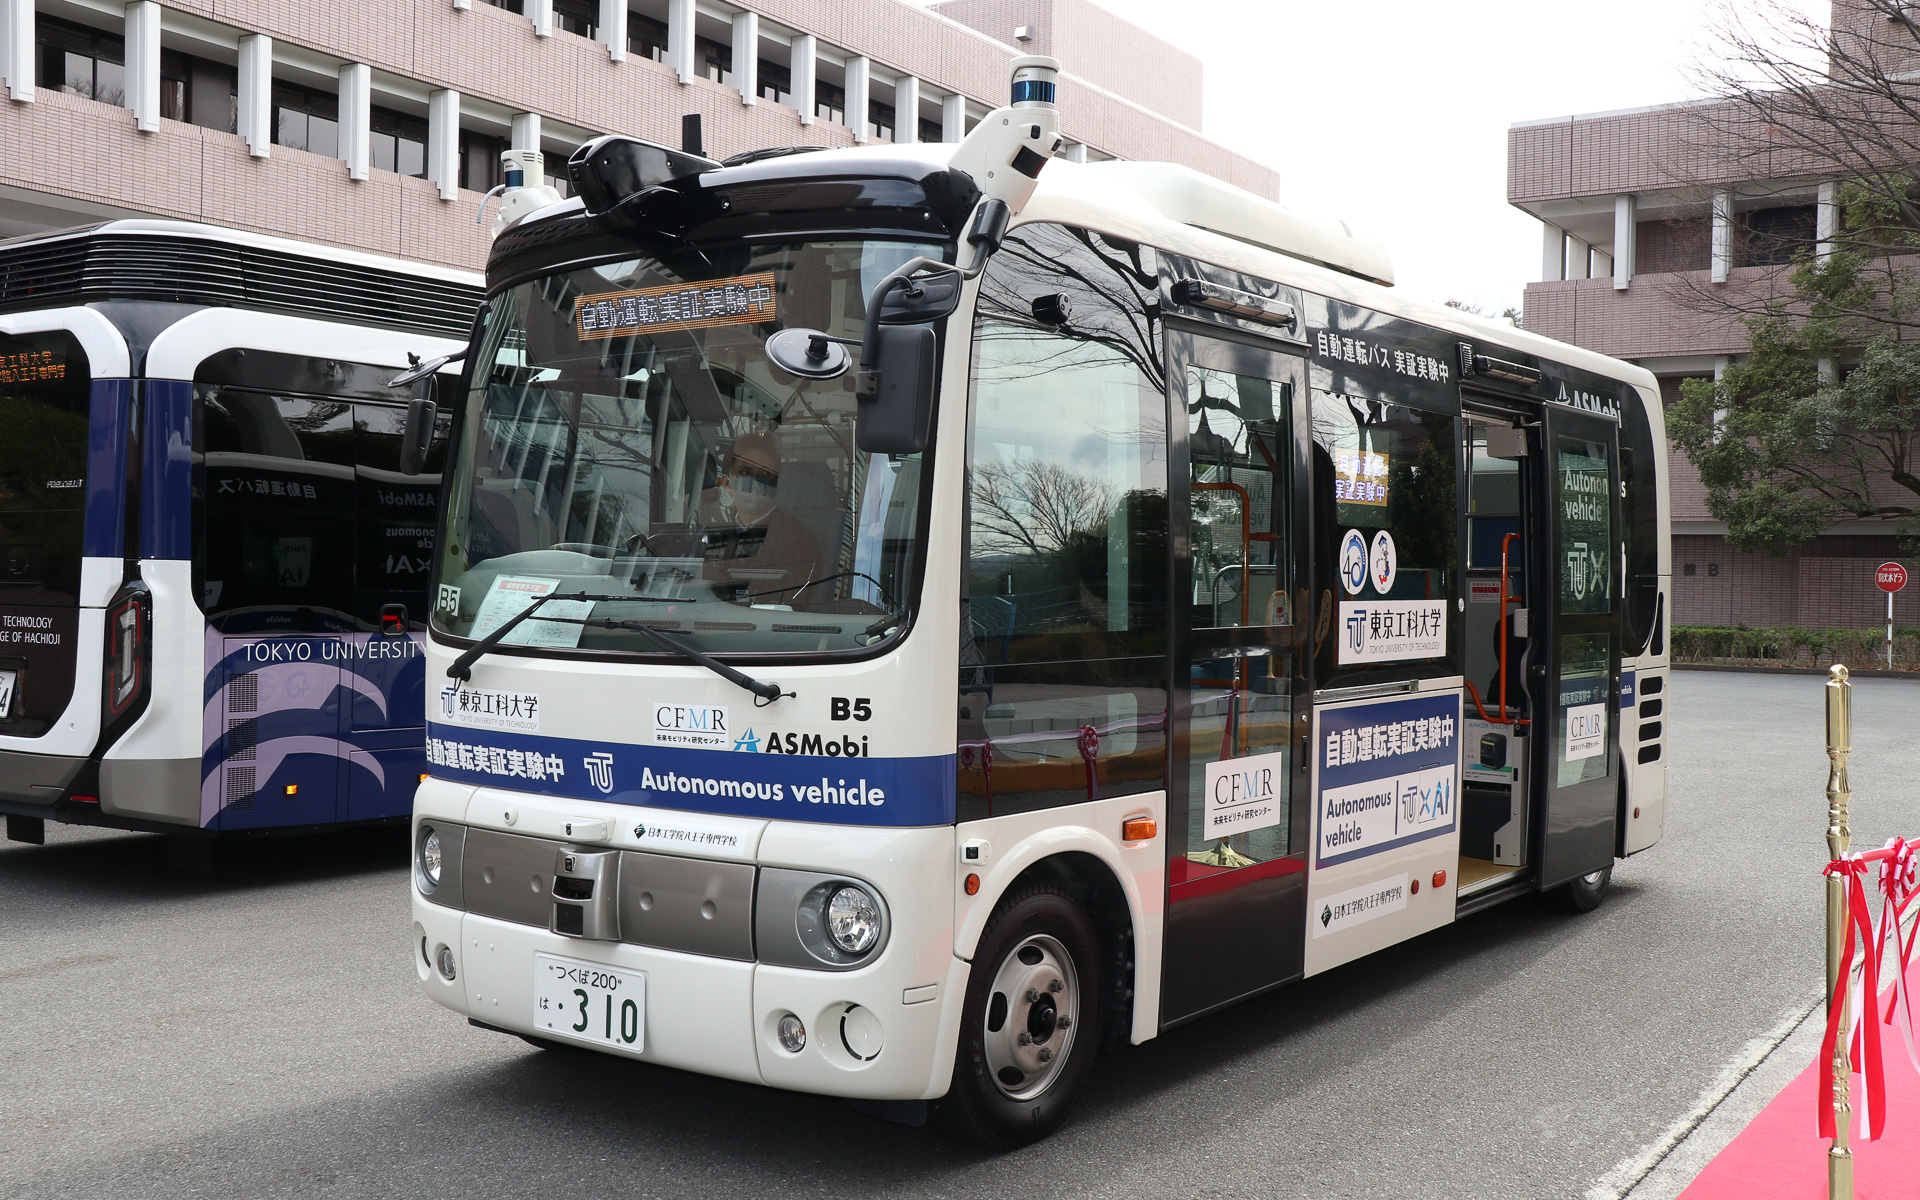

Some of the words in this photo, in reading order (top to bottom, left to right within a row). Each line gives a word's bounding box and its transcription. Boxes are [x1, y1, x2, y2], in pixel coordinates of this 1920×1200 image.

[581, 283, 770, 330] 自動運転実証実験中
[1317, 330, 1391, 369] 自動運転バス
[1394, 349, 1449, 384] 実証実験中
[1335, 478, 1386, 503] 実証実験中
[1708, 563, 1719, 577] B
[439, 587, 459, 614] B5
[3, 615, 53, 629] TECHNOLOGY
[1369, 608, 1441, 640] 東京工科大学
[12, 631, 22, 643] OF
[24, 632, 60, 645] HACHIOJI
[242, 643, 312, 662] TOKYO
[459, 689, 538, 719] 東京工科大学
[830, 697, 872, 721] B5
[656, 706, 727, 731] CFMR
[1571, 713, 1600, 738] CFMR
[656, 734, 725, 745] 未来モビリティ研究センター
[765, 732, 869, 757] ASMobi
[1326, 714, 1454, 769] 自動運転実証実験中
[425, 736, 565, 782] 自動運転実証実験中
[641, 767, 784, 801] Autonomous
[790, 777, 885, 807] vehicle
[1215, 768, 1274, 805] CFMR
[1213, 806, 1272, 826] 未来モビリティ研究センター
[1326, 791, 1392, 819] Autonomous
[648, 827, 738, 847] 日本工学院八王子専門学校
[1325, 820, 1362, 848] vehicle
[1334, 886, 1402, 920] 日本工学院八王子専門学校
[539, 996, 549, 1010] は
